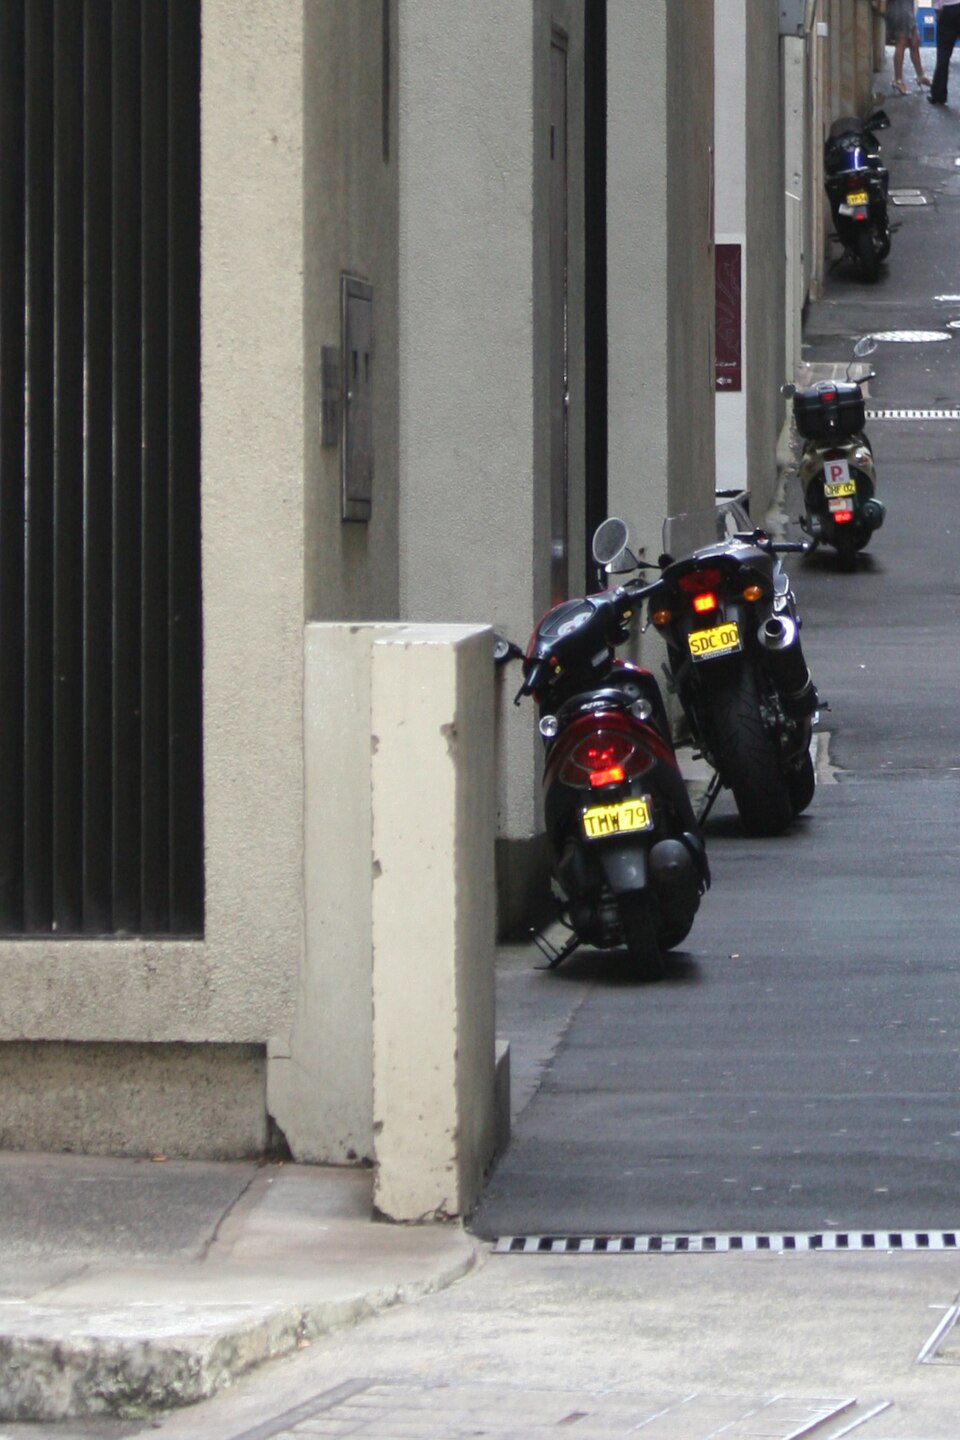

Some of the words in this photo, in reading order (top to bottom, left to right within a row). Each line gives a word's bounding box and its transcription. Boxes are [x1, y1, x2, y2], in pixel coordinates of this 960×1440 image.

[830, 465, 843, 482] P
[690, 634, 718, 653] SDC
[624, 806, 647, 826] 79
